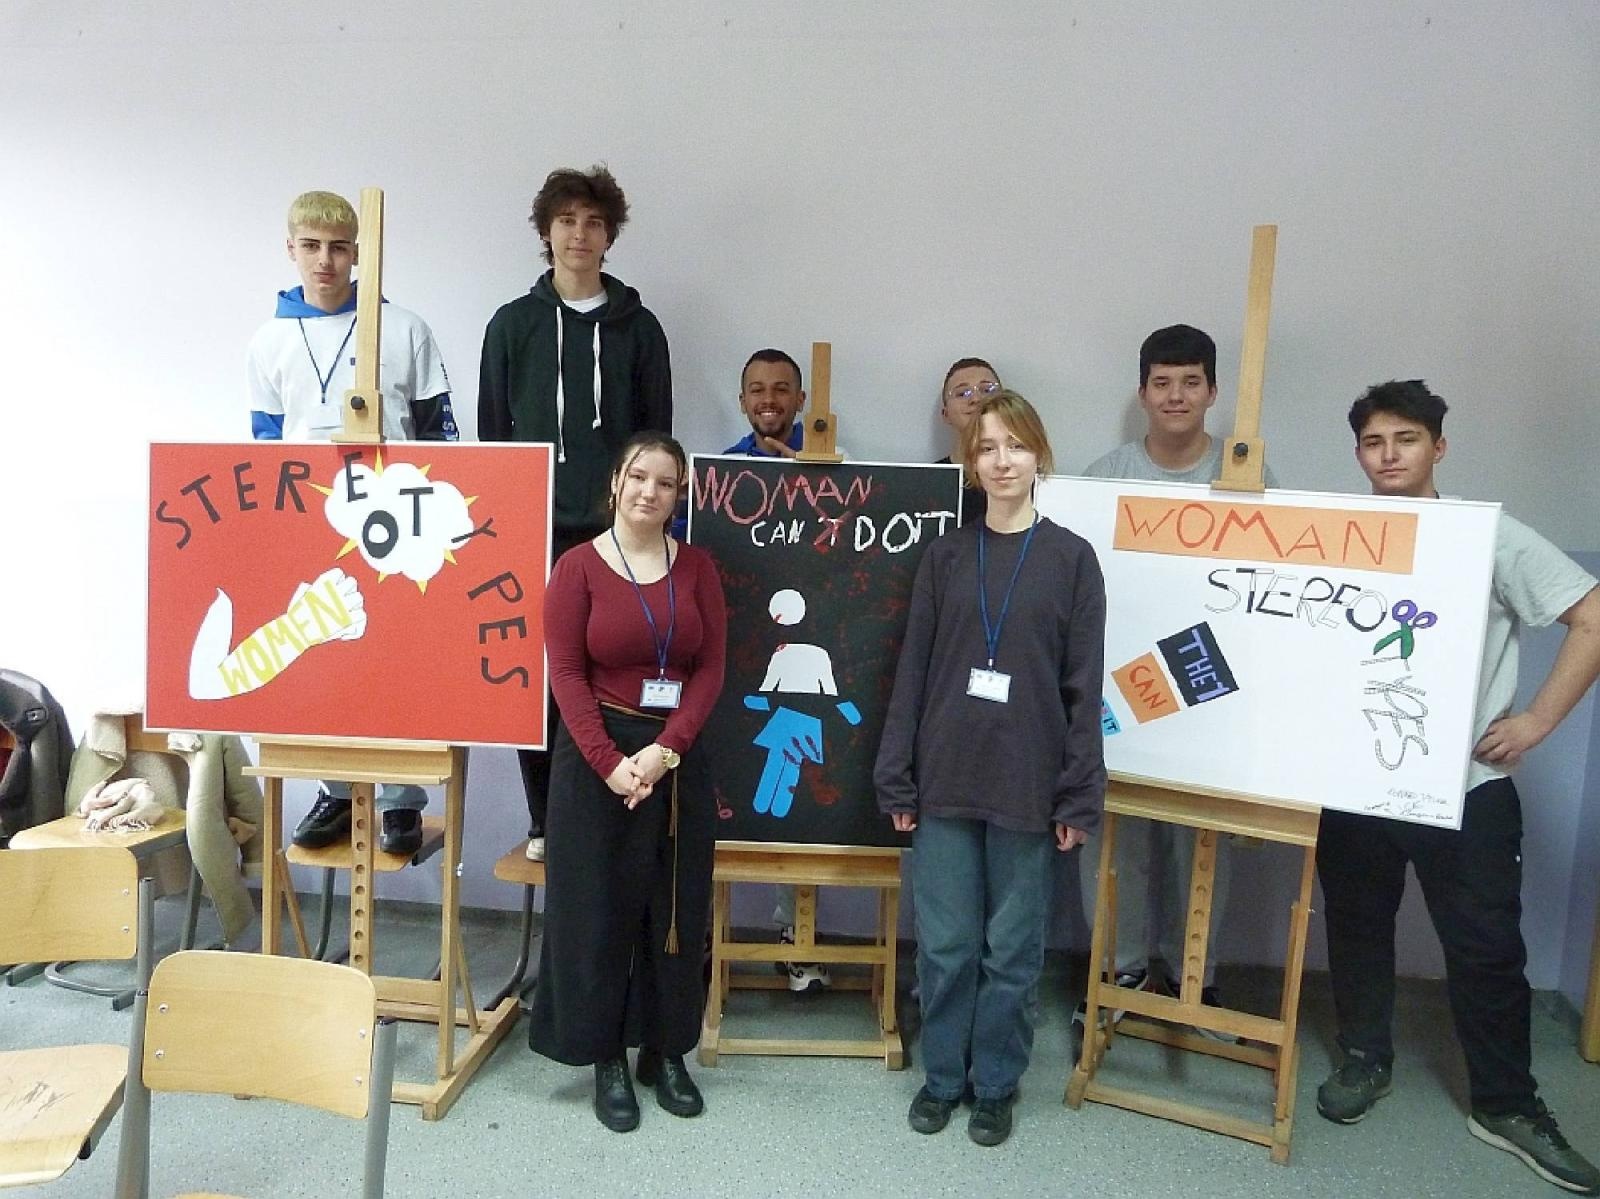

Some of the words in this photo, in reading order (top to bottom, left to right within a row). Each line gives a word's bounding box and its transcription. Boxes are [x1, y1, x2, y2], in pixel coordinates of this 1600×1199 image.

[693, 466, 873, 525] WOMAN
[1124, 502, 1388, 566] WOMAN
[156, 451, 529, 688] STEREOTYPES
[1204, 567, 1388, 632] STEREO
[217, 579, 352, 695] WOMEN
[1129, 664, 1168, 710] CAN
